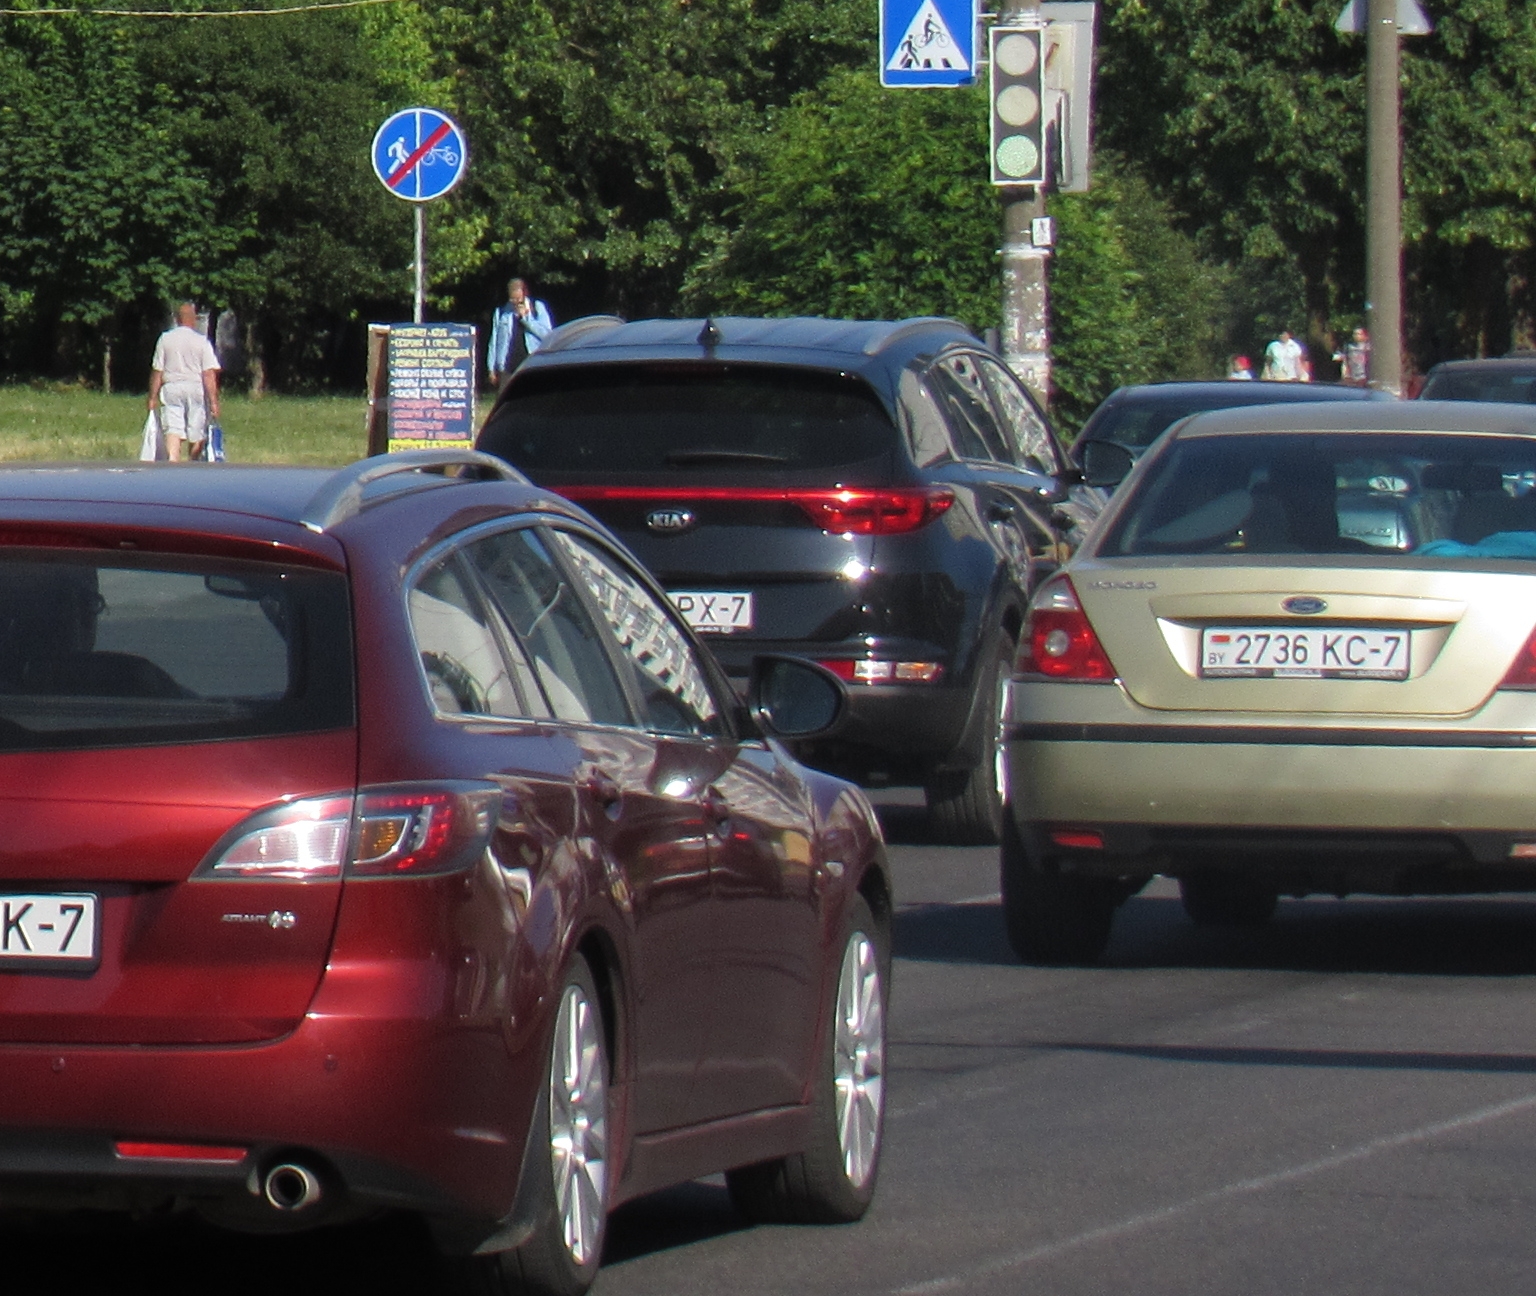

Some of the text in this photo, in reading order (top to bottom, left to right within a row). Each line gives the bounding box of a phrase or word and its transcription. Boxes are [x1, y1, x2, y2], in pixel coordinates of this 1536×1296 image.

[652, 513, 683, 527] KIA
[1234, 633, 1401, 667] 2736 KC-7
[1208, 652, 1225, 664] BY
